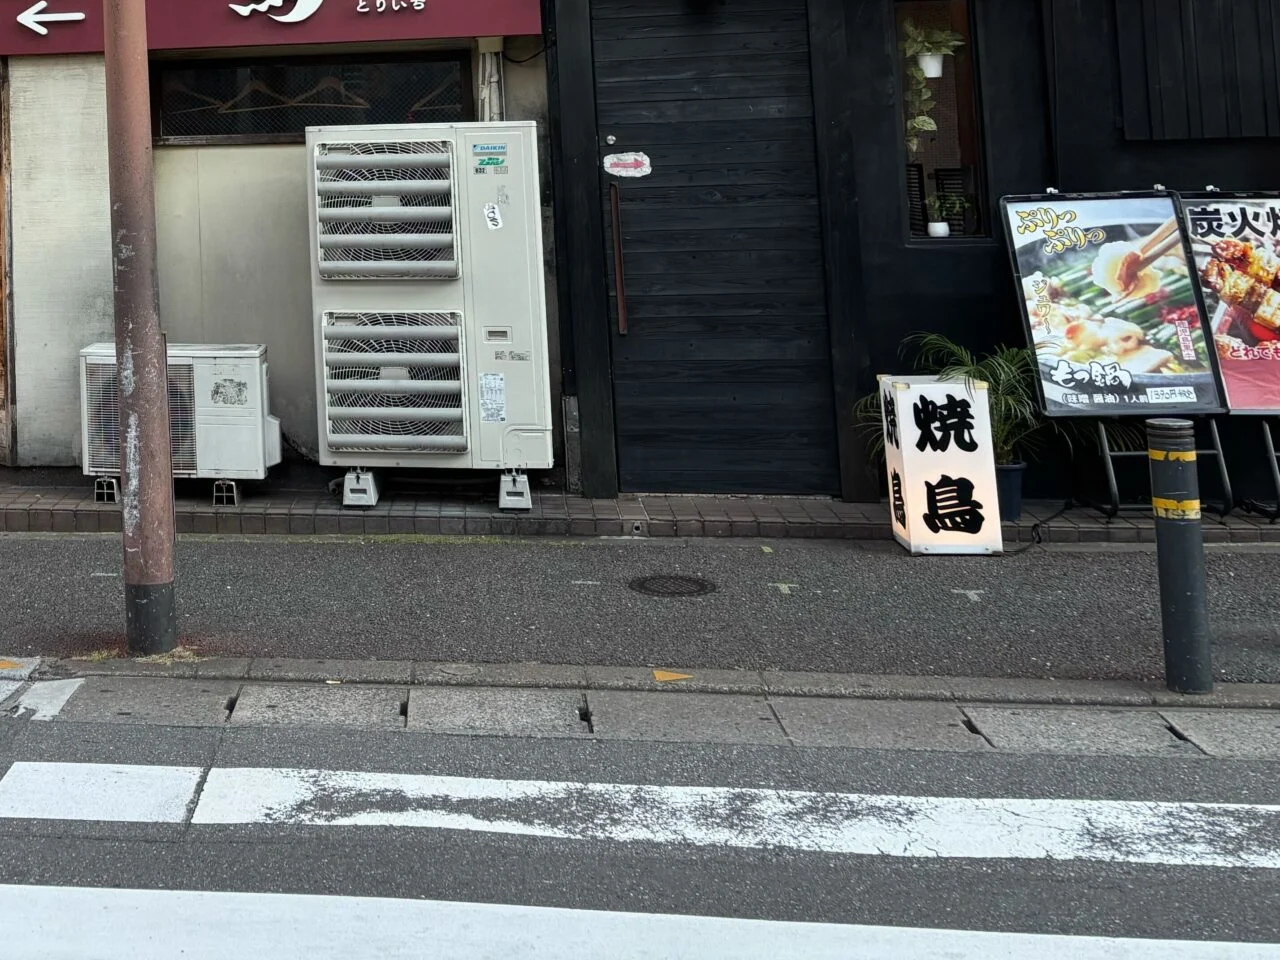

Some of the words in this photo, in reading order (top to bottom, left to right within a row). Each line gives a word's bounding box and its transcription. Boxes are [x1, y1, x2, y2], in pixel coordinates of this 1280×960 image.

[1050, 359, 1134, 390] もつ鍋
[913, 393, 986, 534] 焼鳥
